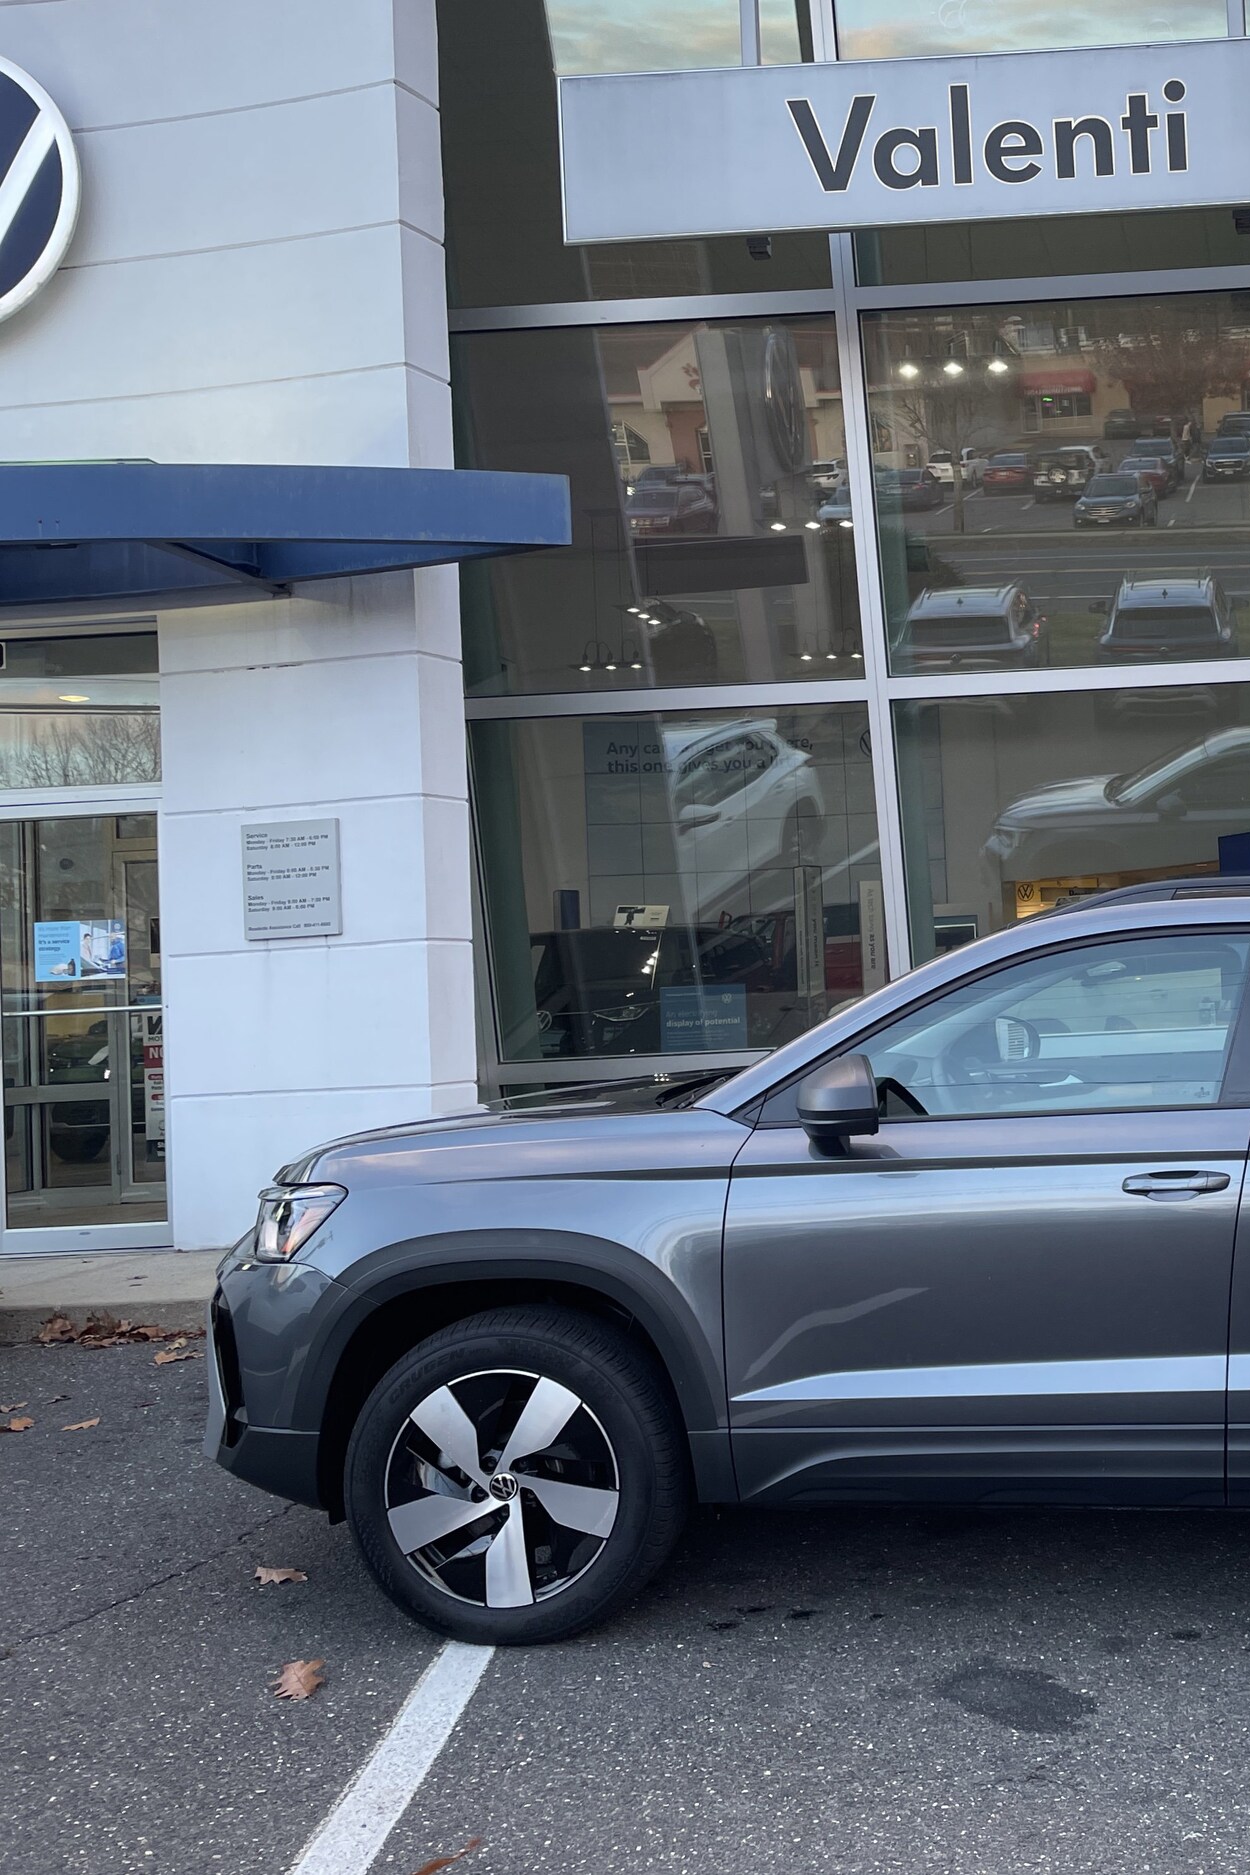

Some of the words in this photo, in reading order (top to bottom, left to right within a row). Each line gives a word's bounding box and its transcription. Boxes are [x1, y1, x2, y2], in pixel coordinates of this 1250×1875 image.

[787, 79, 1189, 193] Valenti
[607, 741, 638, 758] Any
[608, 760, 638, 774] this
[643, 761, 673, 774] one
[724, 759, 752, 774] you
[757, 759, 766, 769] a
[868, 943, 876, 957] you
[666, 1019, 694, 1029] display
[695, 1018, 703, 1027] of
[704, 1016, 740, 1028] potential
[388, 1346, 466, 1406] CRUGEN
